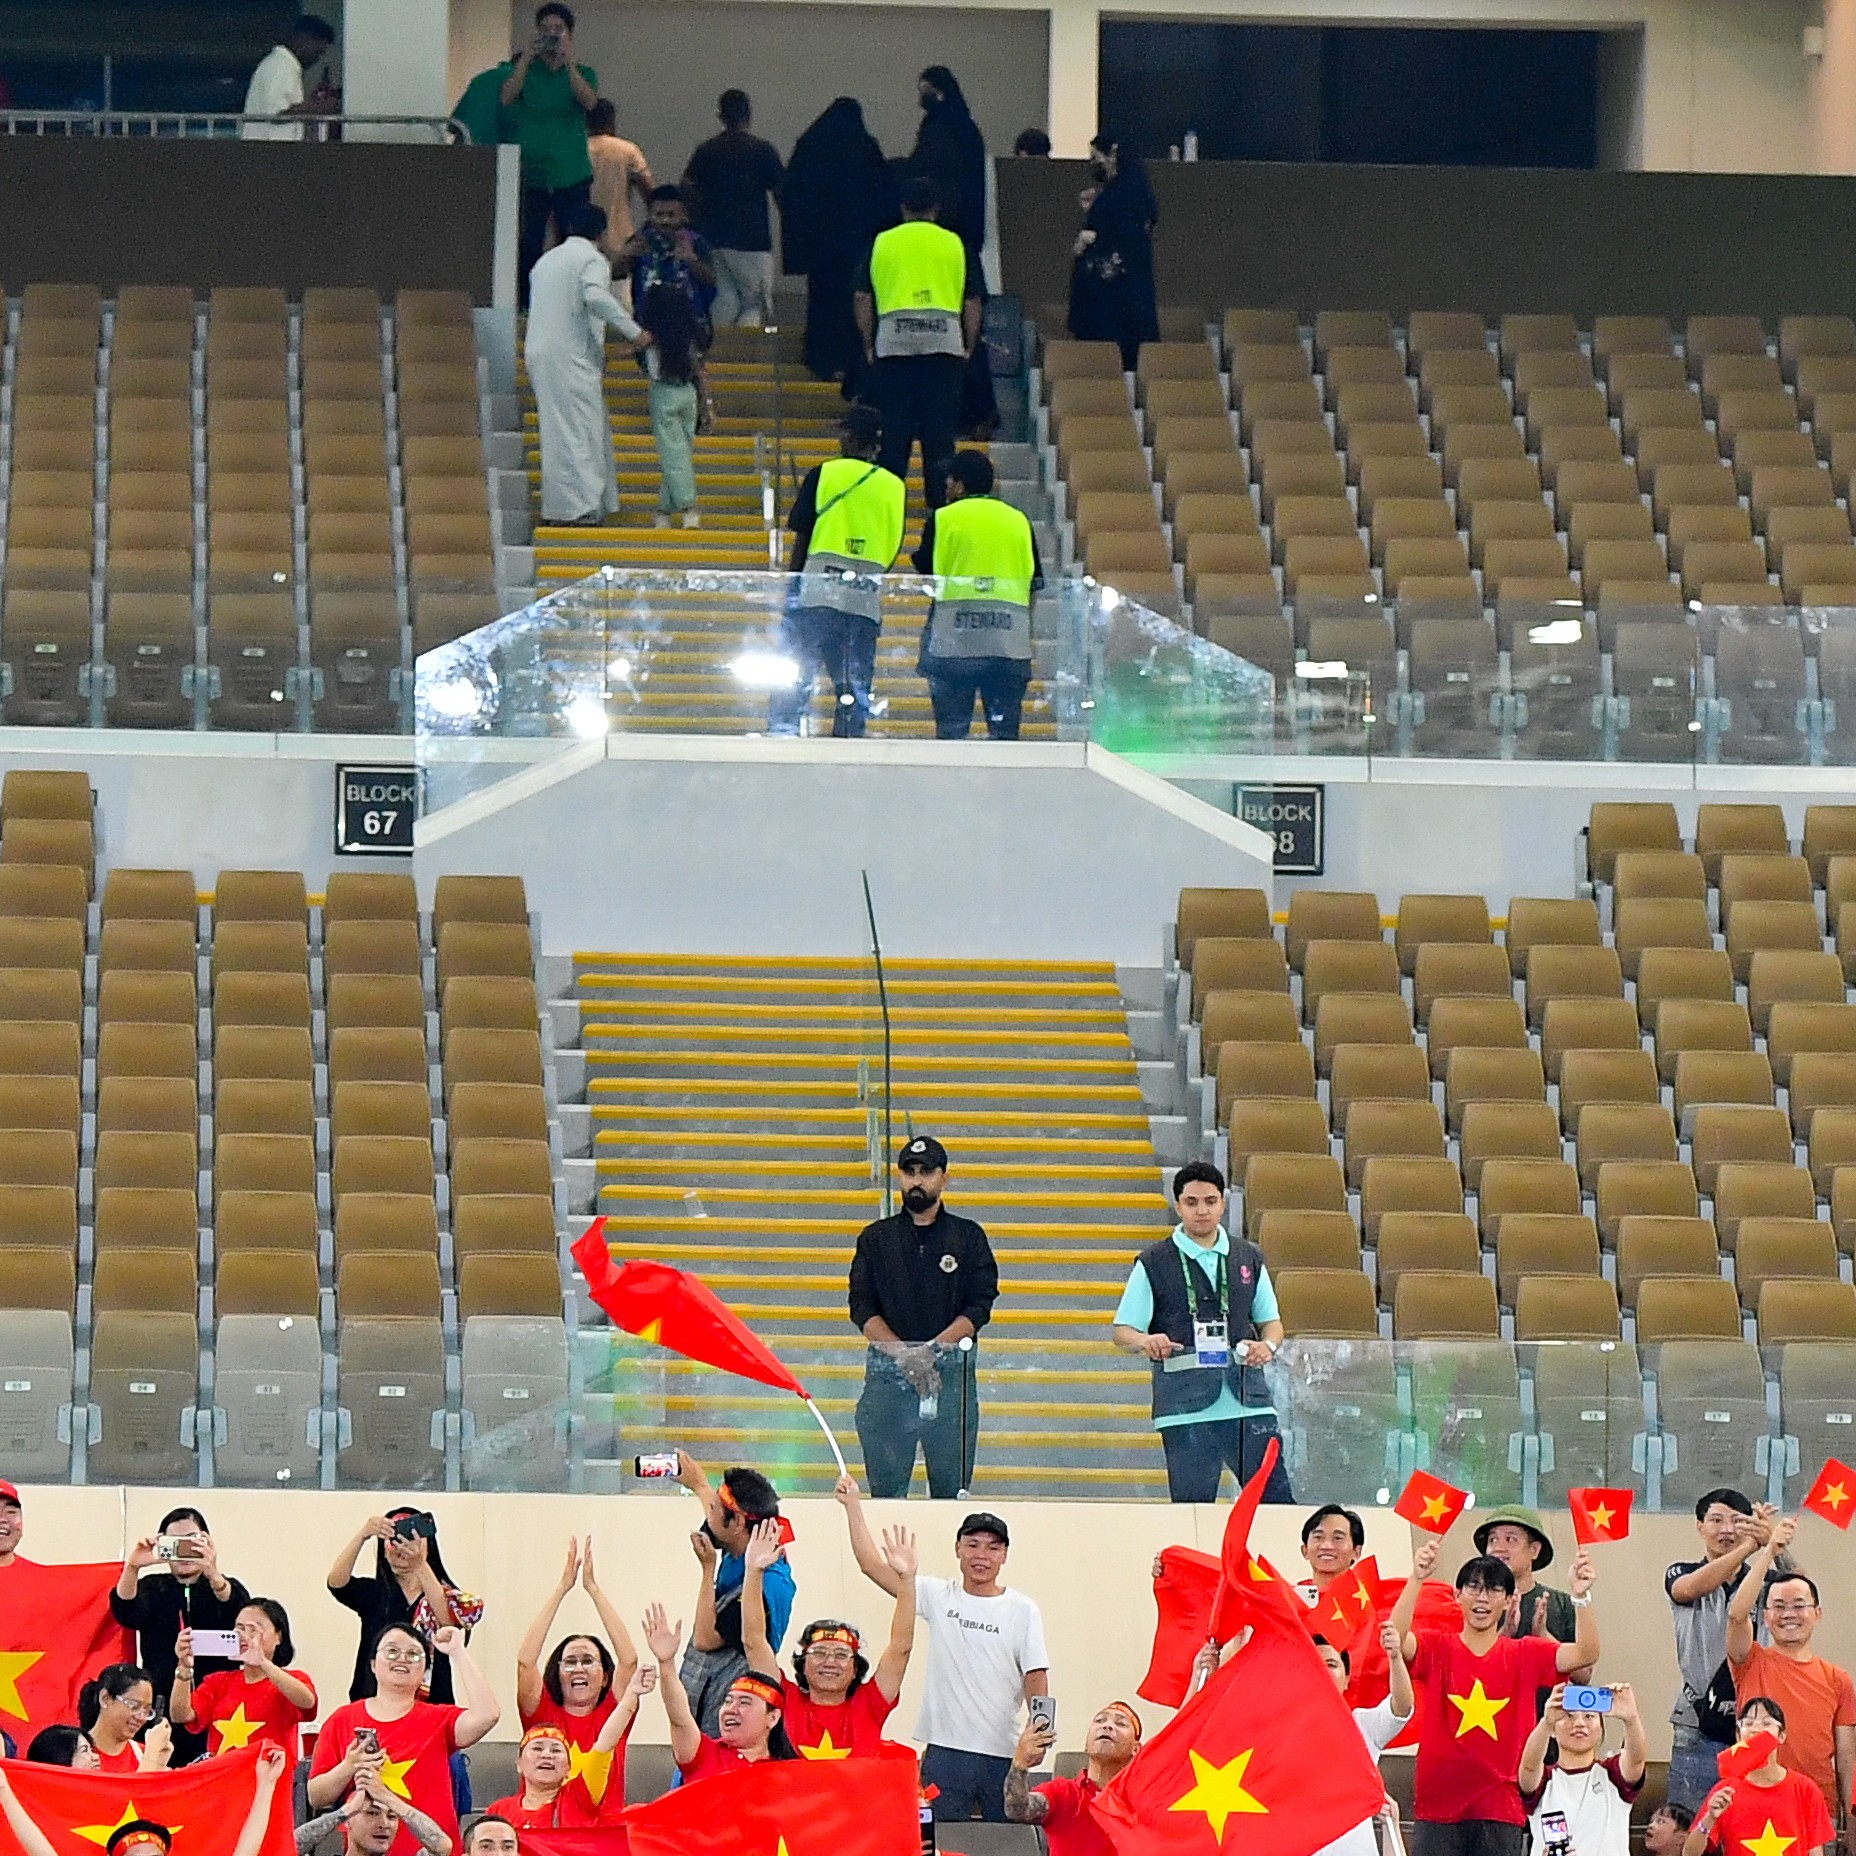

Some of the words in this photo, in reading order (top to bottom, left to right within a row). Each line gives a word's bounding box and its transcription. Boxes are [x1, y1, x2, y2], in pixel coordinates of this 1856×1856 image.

[347, 784, 415, 803] BLOCK
[363, 810, 400, 836] 67
[1244, 803, 1312, 823] BLOCK
